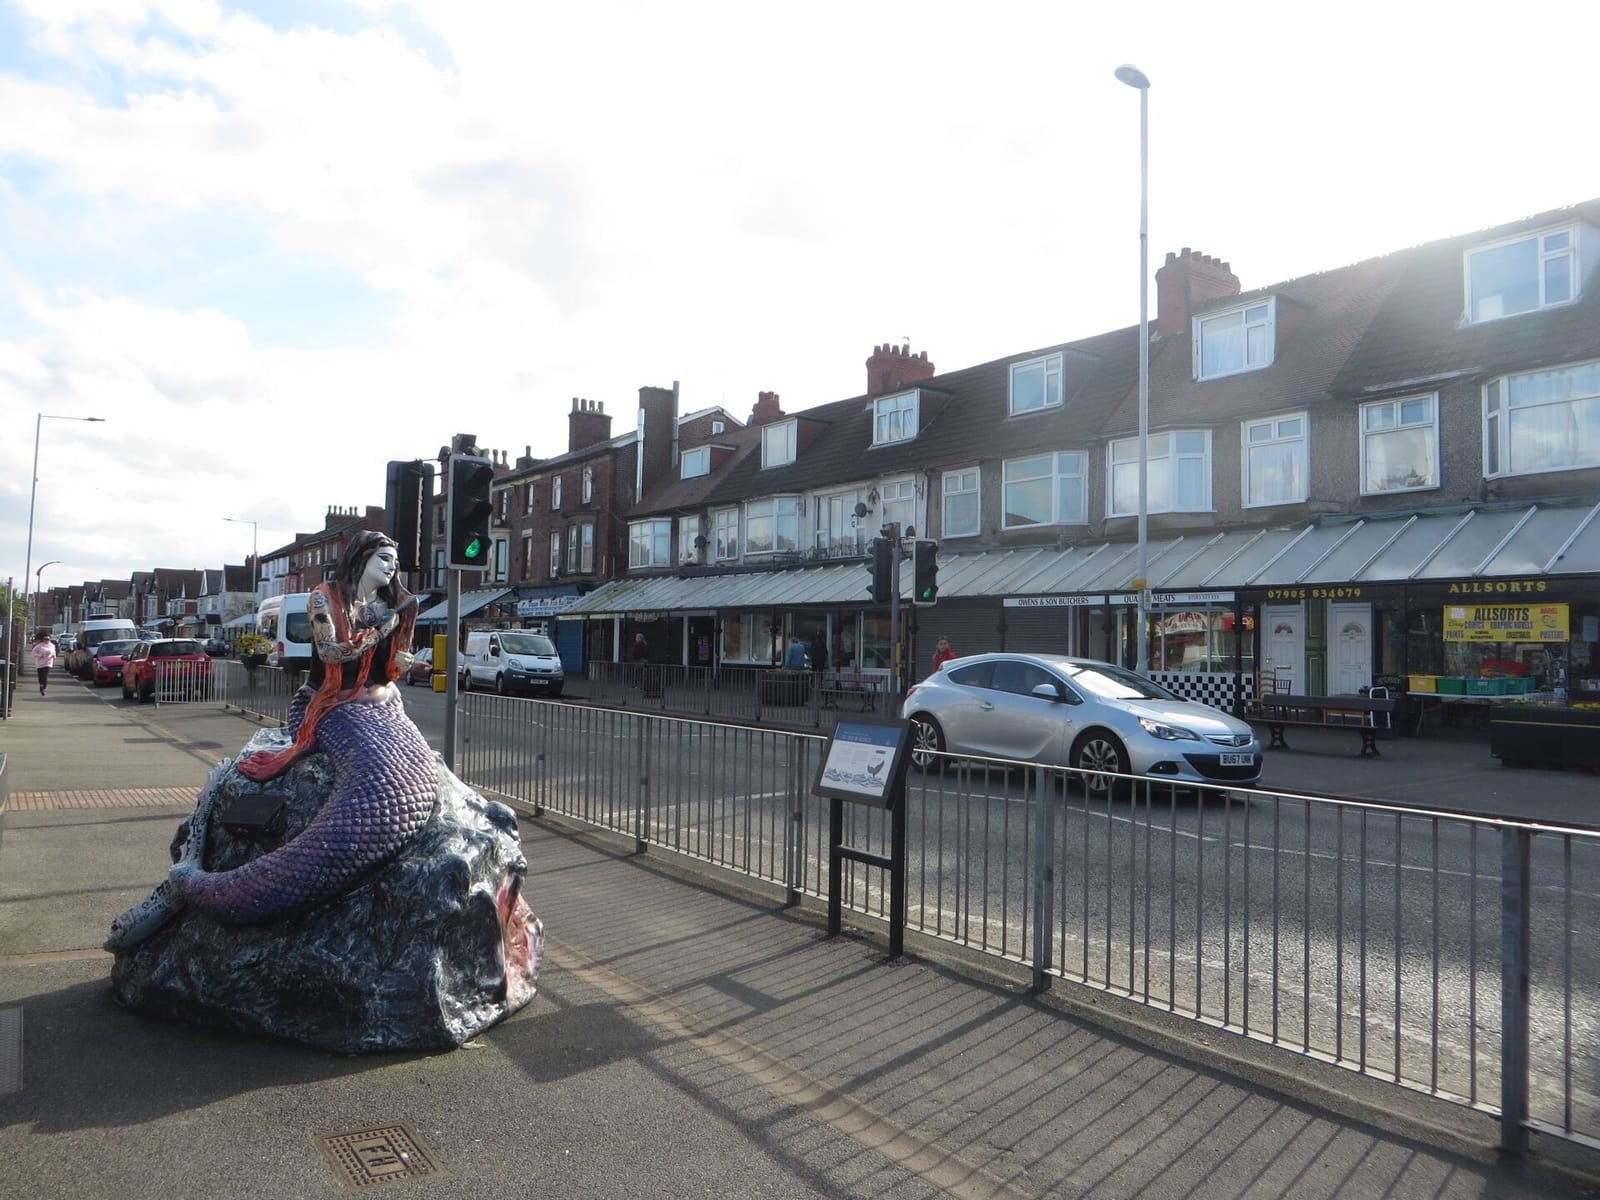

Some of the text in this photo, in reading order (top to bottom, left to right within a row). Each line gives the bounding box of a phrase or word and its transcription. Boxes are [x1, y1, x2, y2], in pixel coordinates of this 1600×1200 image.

[1449, 581, 1547, 593] ALLSORTS
[1153, 594, 1175, 603] MEATS
[1268, 588, 1361, 599] 07905 834679
[1018, 598, 1039, 606] OWENS
[1058, 597, 1089, 605] BUTCHERS
[1474, 607, 1530, 622] ALLSORTS
